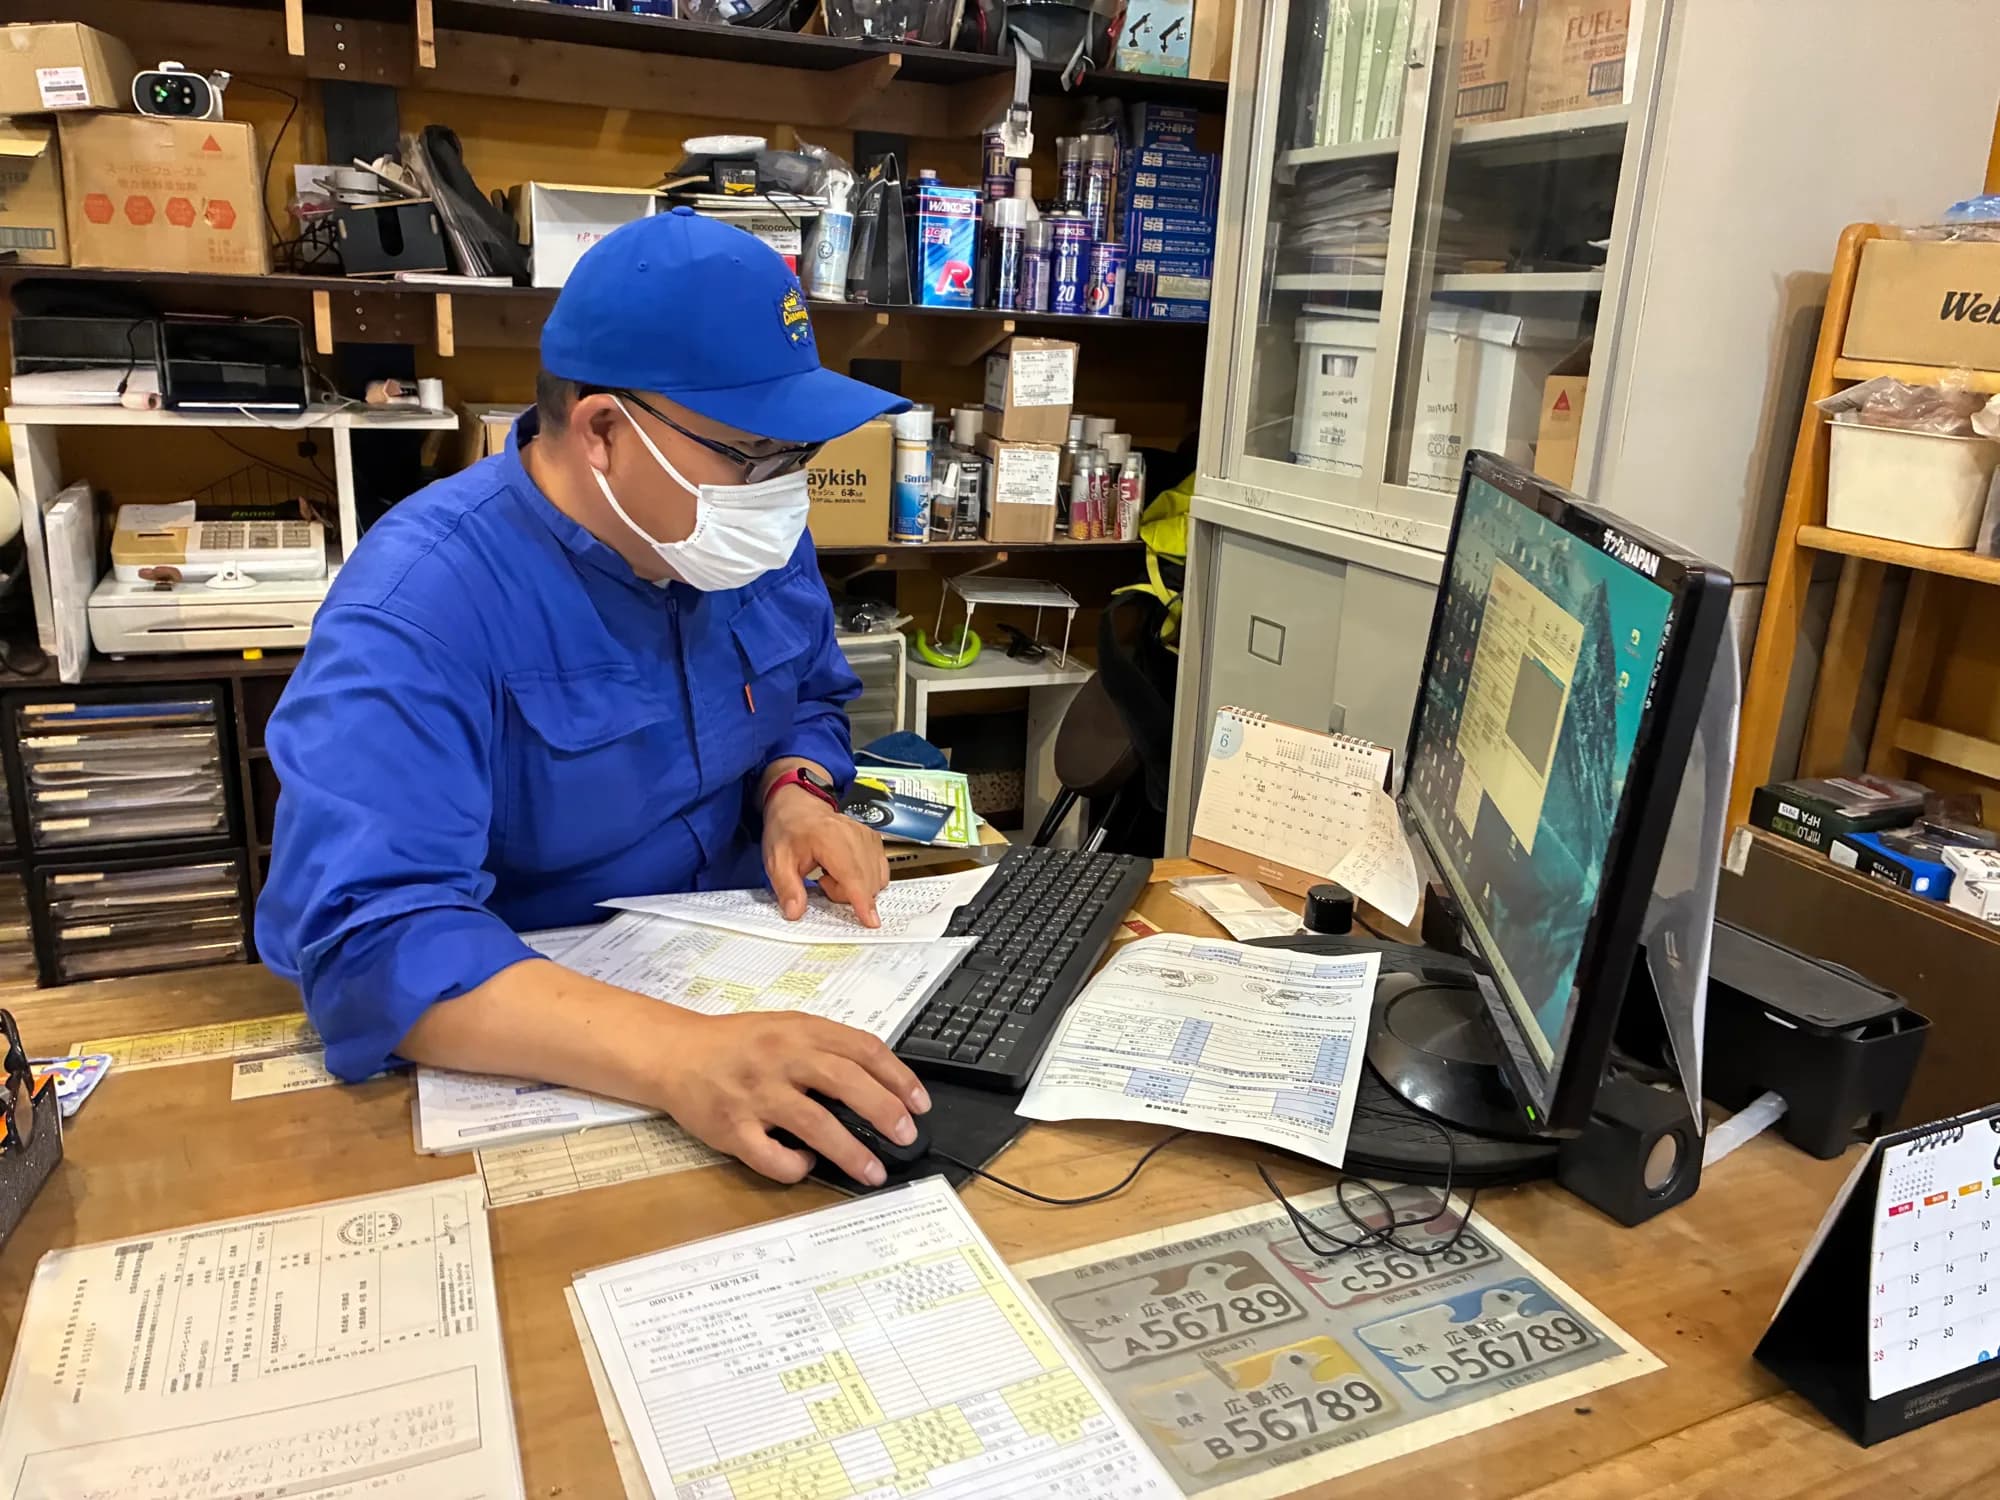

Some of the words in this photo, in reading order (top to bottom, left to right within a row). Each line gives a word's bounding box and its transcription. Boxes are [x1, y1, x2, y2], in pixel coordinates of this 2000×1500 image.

[1057, 285, 1076, 303] 20
[1939, 291, 2000, 325] Web
[806, 468, 867, 490] aykish
[1220, 733, 1230, 748] 6
[1801, 811, 1822, 829] HFA
[1951, 1199, 1957, 1209] 2
[1910, 1272, 1920, 1285] 15
[1945, 1262, 1955, 1274] 16
[1979, 1251, 1989, 1263] 17
[1139, 1288, 1209, 1318] 広島市
[1873, 1316, 1883, 1329] 21
[1908, 1305, 1919, 1318] 22
[1943, 1294, 1954, 1306] 23
[1977, 1283, 1988, 1295] 24
[1123, 1288, 1292, 1357] A56789
[1443, 1316, 1507, 1347] 広島市
[1430, 1316, 1588, 1385] D56789
[1873, 1349, 1885, 1362] 28
[1908, 1337, 1919, 1351] 29
[1943, 1326, 1954, 1339] 30
[1224, 1381, 1295, 1417] 広島市
[1203, 1380, 1384, 1461] B56789
